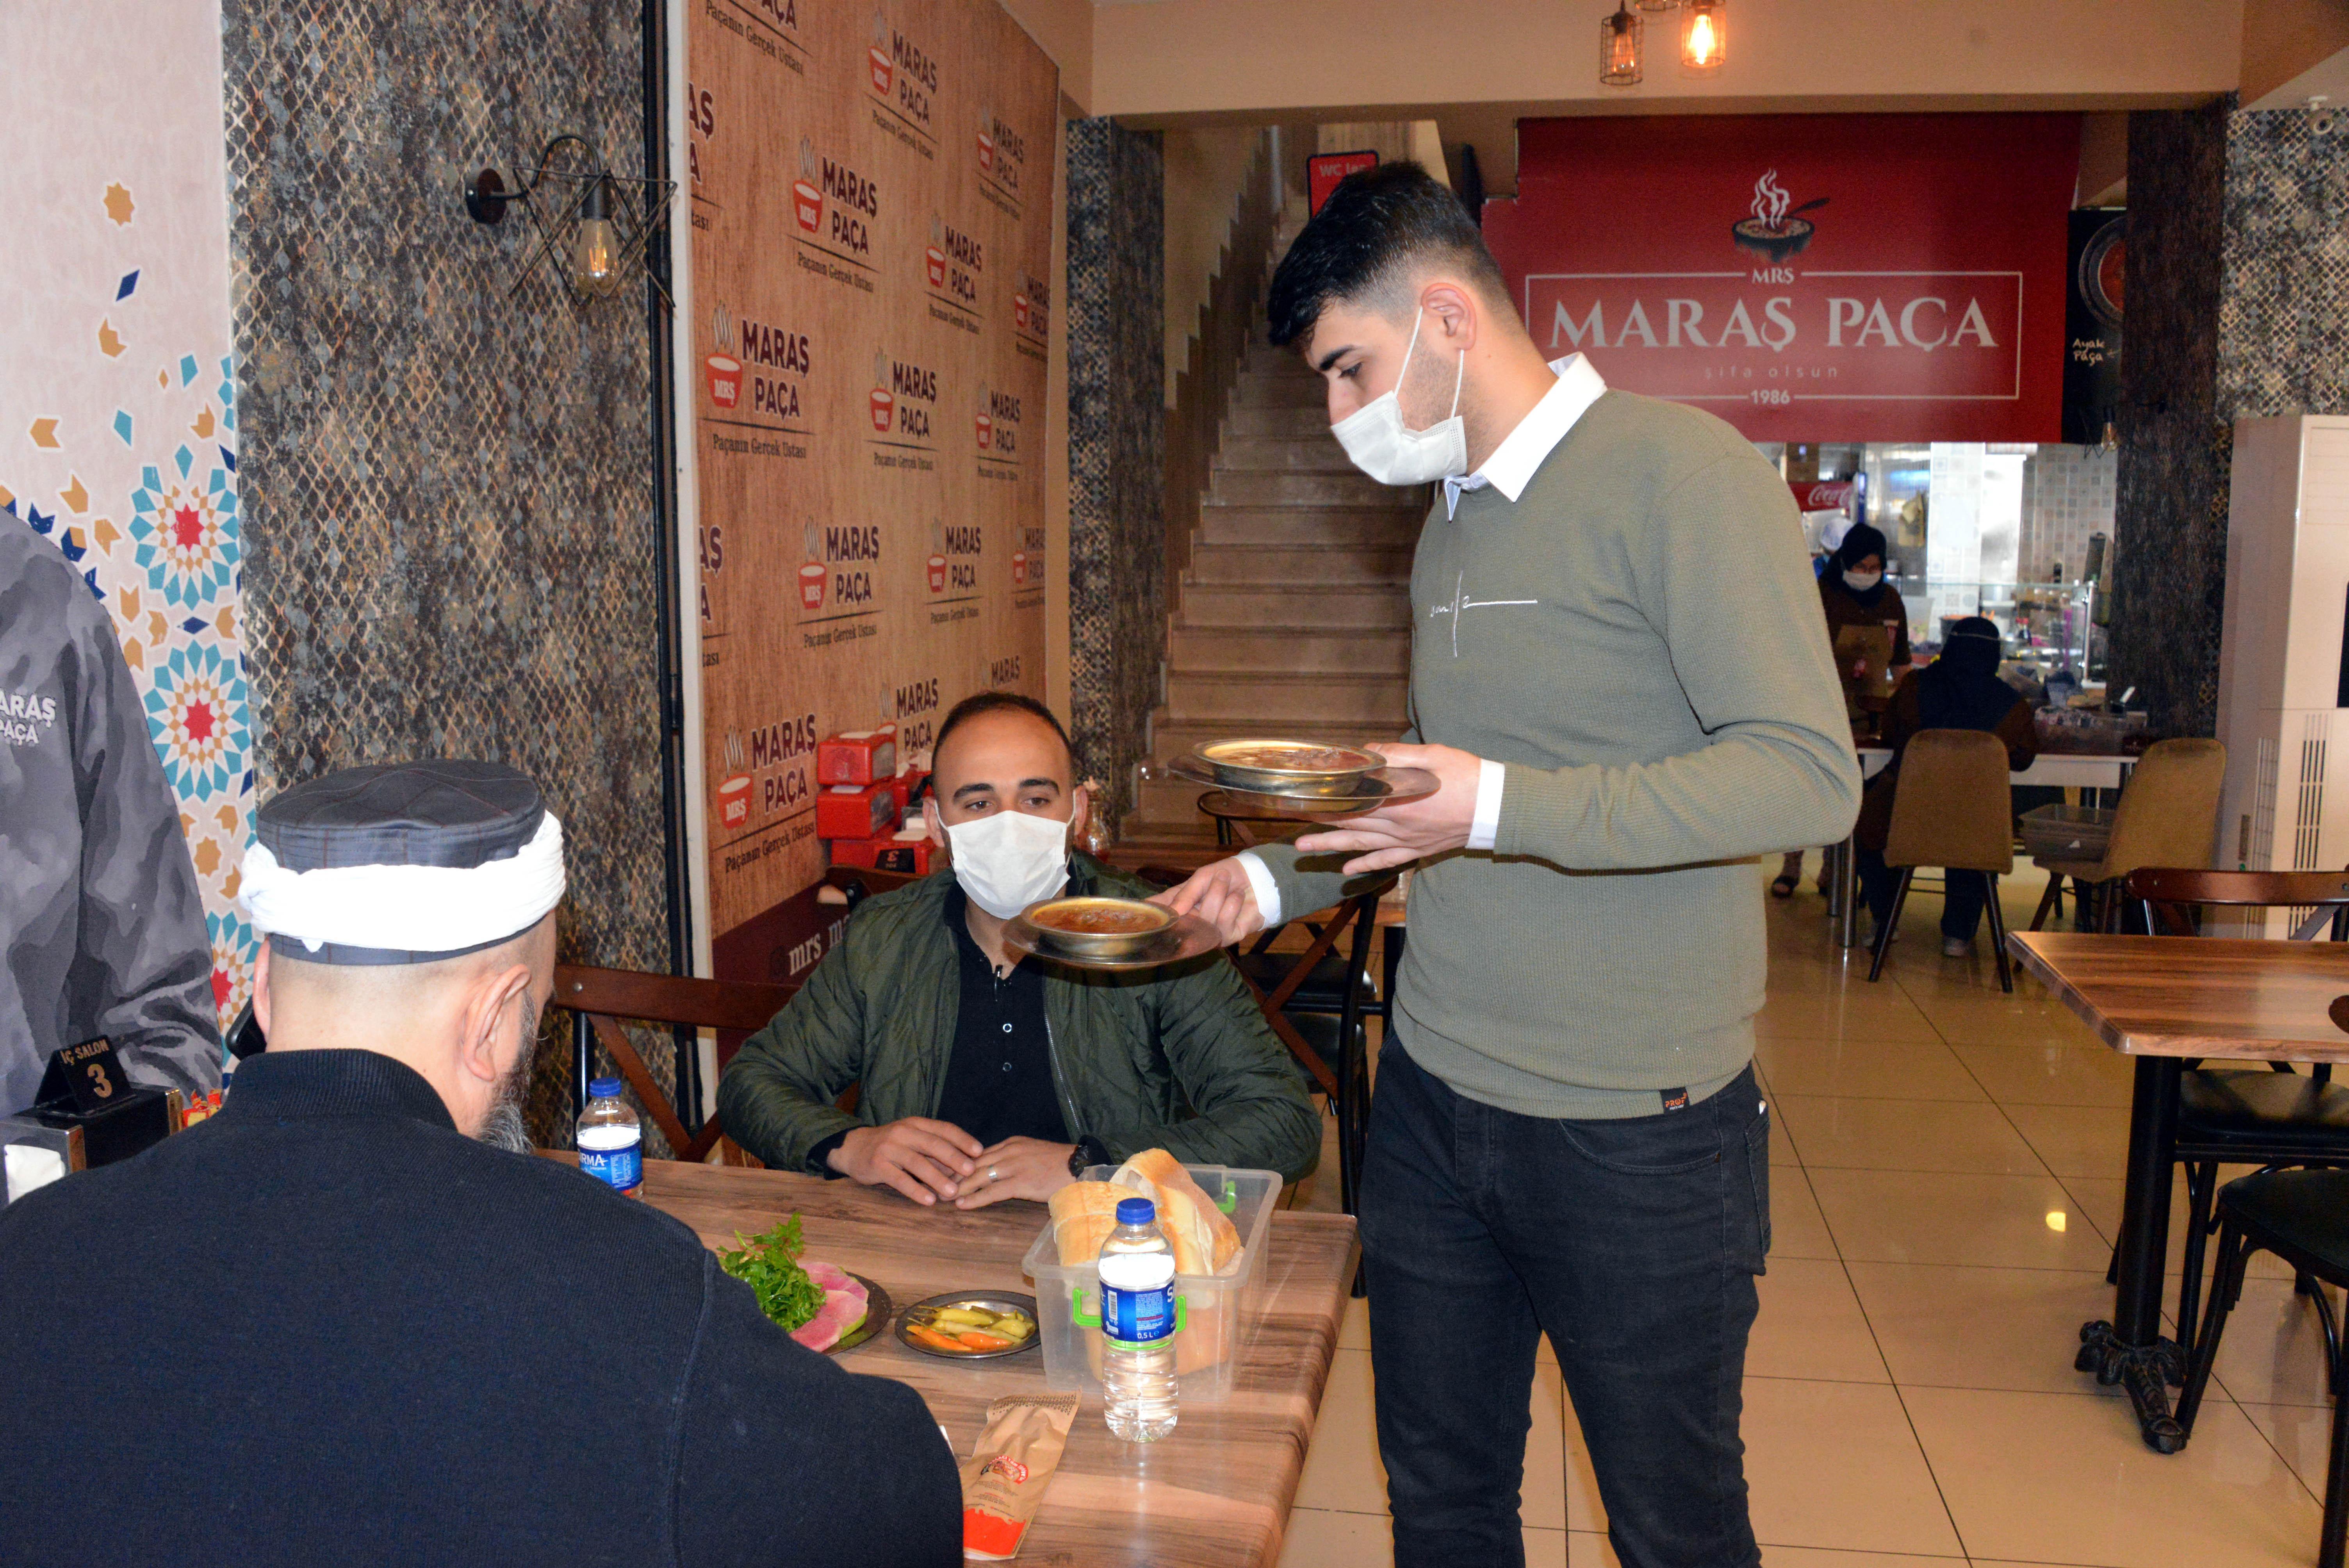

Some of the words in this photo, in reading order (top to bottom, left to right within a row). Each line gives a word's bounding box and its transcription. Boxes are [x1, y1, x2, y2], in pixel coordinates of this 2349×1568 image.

[823, 157, 877, 219] MARAŞ
[833, 210, 868, 254] PAÇA
[1751, 267, 1795, 285] MRŞ
[1549, 297, 1797, 351] MARAŞ
[1826, 296, 1999, 351] PAÇA
[743, 319, 809, 377] MARAŞ
[893, 361, 936, 405] MARAŞ
[1768, 365, 1837, 378] olsun
[756, 377, 800, 420] PAÇA
[1750, 389, 1791, 404] 1986
[901, 406, 930, 440] PAÇA
[827, 526, 879, 563] MARAŞ
[837, 572, 872, 606] PAÇA
[0, 687, 56, 728] ARAŞ
[752, 714, 816, 770] MARAŞ
[765, 767, 807, 812] PAÇA
[789, 934, 822, 975] mrs
[75, 1039, 109, 1059] SALON
[87, 1064, 112, 1098] 3
